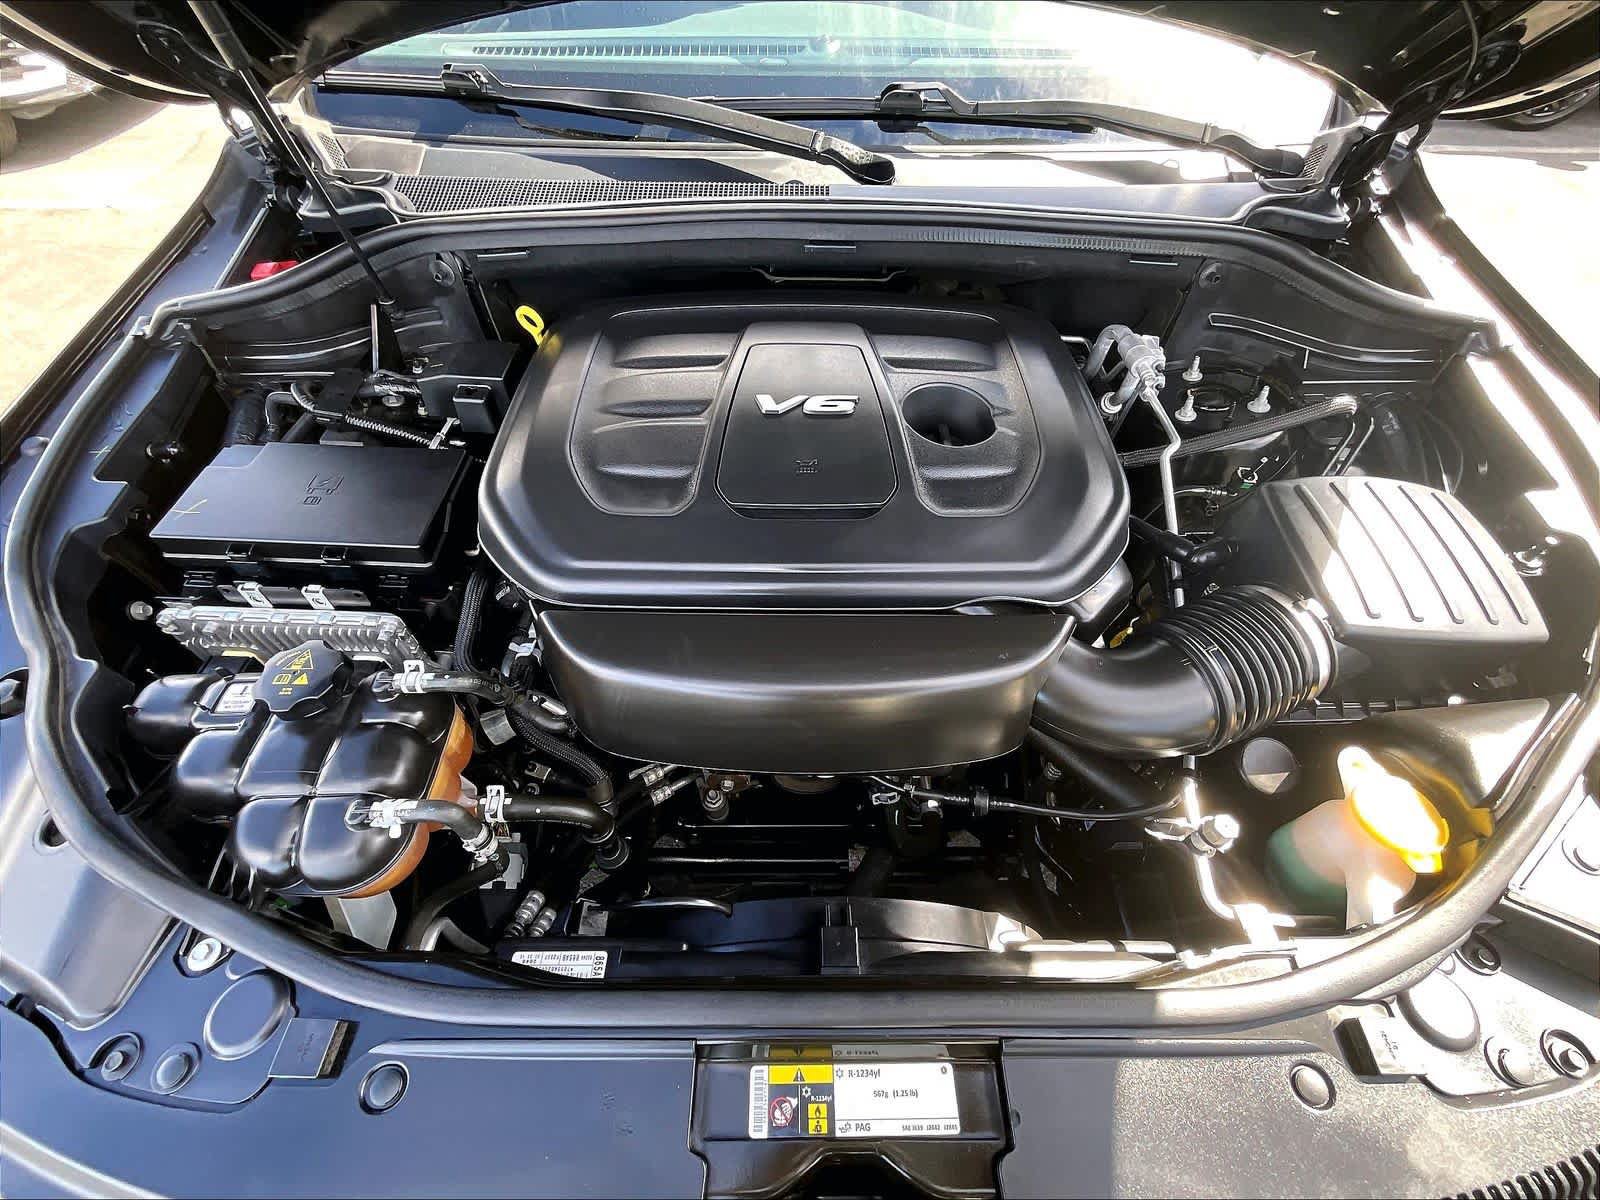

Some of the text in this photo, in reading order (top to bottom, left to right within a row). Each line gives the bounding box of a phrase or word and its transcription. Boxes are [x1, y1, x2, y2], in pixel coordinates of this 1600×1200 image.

[754, 393, 860, 415] V6
[592, 955, 605, 977] 865A
[848, 1068, 881, 1079] R-1234yf
[873, 1090, 888, 1099] 567g
[855, 1123, 871, 1132] PAG
